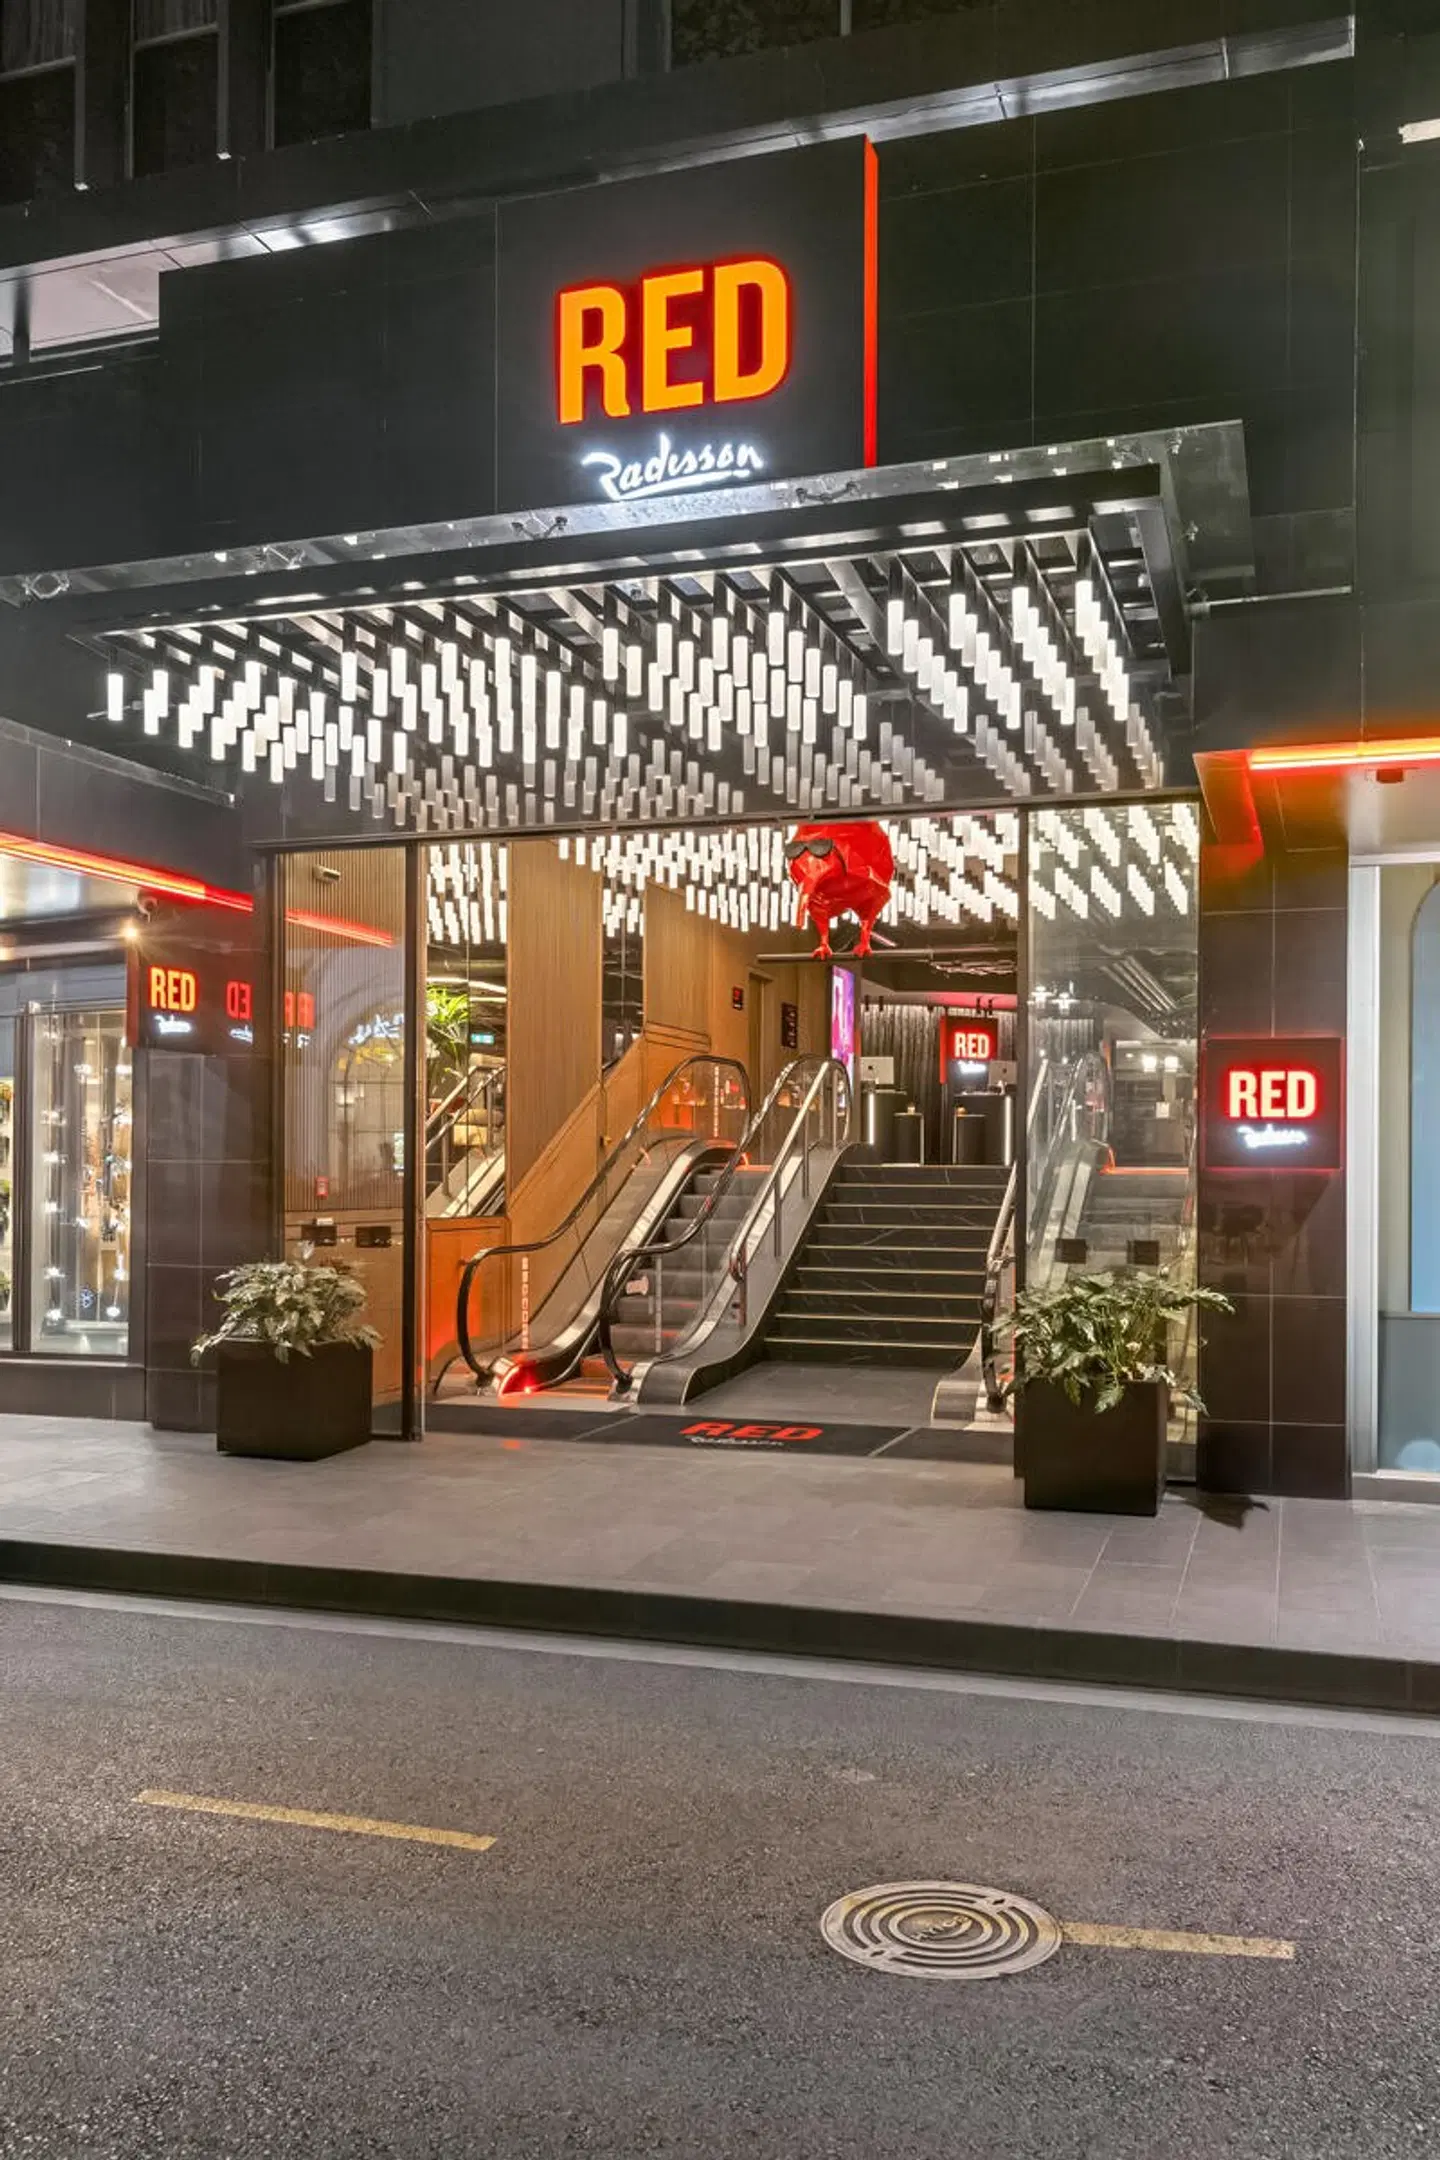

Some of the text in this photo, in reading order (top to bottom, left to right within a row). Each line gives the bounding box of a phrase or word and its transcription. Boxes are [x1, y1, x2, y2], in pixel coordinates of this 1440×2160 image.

[559, 260, 788, 424] RED
[580, 432, 765, 501] Radisson
[150, 966, 196, 1012] RED
[954, 1032, 990, 1058] RED
[1229, 1070, 1317, 1118] RED
[679, 1421, 823, 1440] RED
